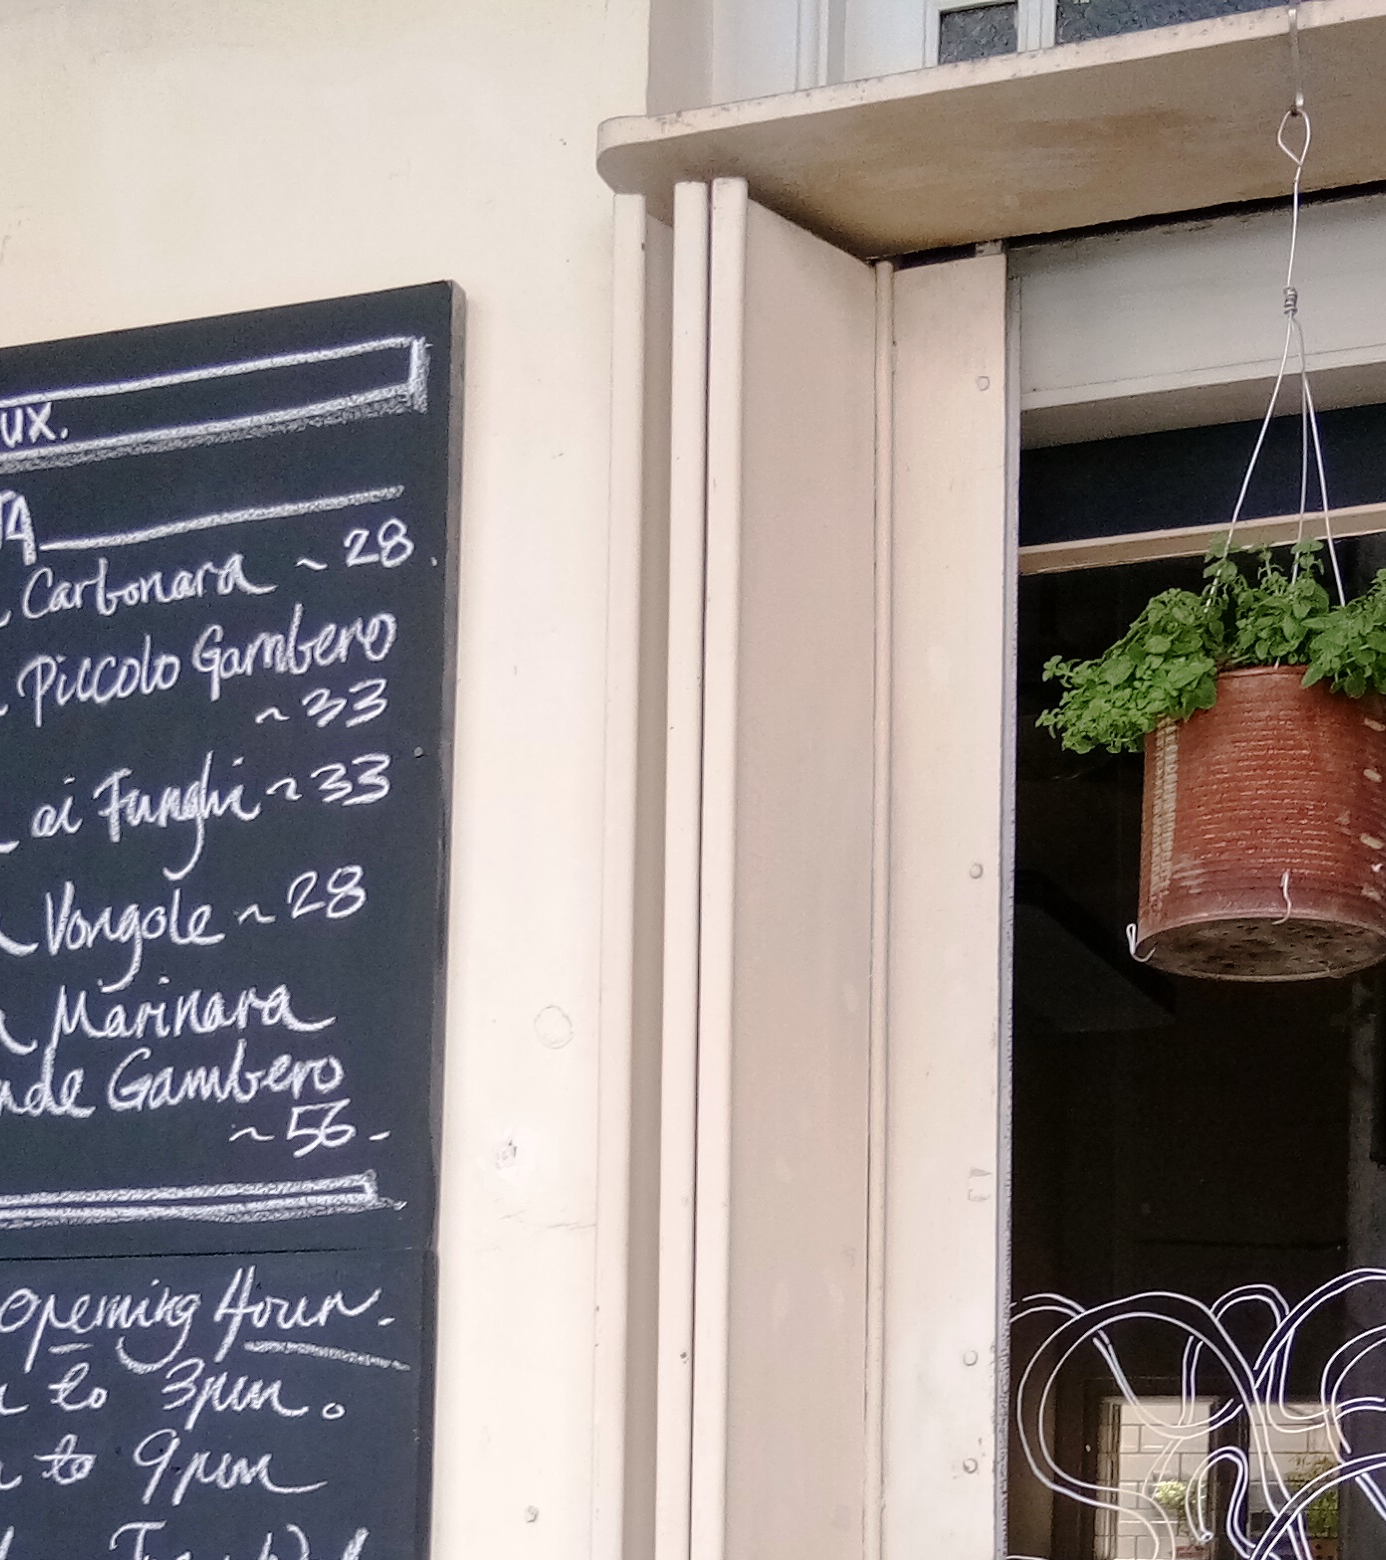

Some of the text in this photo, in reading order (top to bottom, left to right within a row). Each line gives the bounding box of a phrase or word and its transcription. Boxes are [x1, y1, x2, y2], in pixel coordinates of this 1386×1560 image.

[22, 553, 278, 620] Carbonara
[18, 635, 181, 727] Piccolo
[191, 602, 397, 701] Gambero
[93, 751, 261, 881] Funghi
[46, 881, 225, 993] Vongole
[50, 976, 336, 1060] Marinara
[108, 1040, 345, 1111] Gambero
[50, 1363, 107, 1411] to
[35, 1434, 98, 1483] to
[133, 1429, 327, 1505] 9pm
